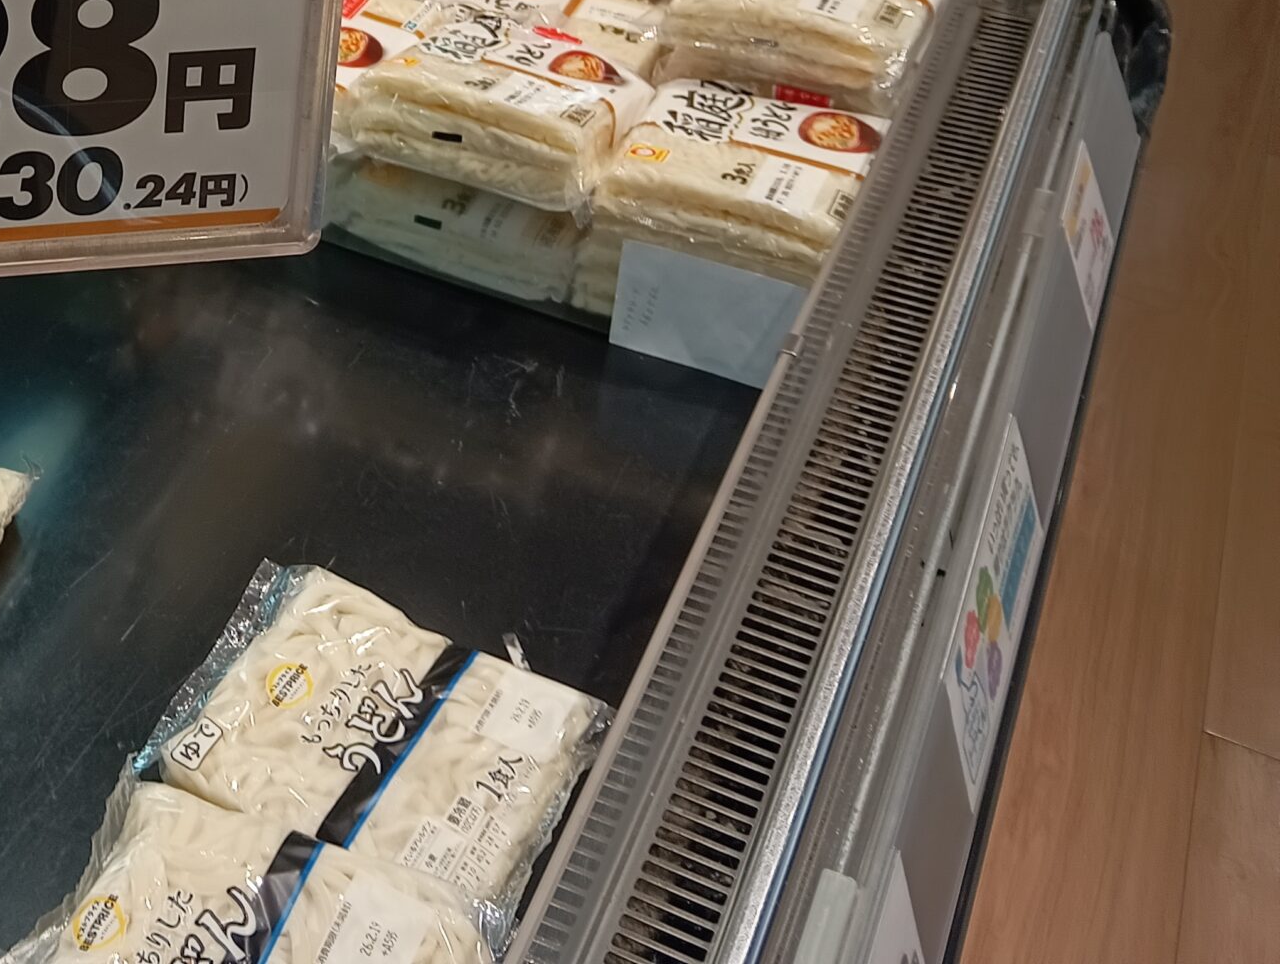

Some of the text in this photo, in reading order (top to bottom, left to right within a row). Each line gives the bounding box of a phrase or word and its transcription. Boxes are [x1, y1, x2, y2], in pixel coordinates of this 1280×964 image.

[271, 662, 309, 708] BESTPRICE
[179, 721, 217, 763] ゆで
[322, 668, 424, 775] うどん
[78, 893, 120, 953] BESTPRICE
